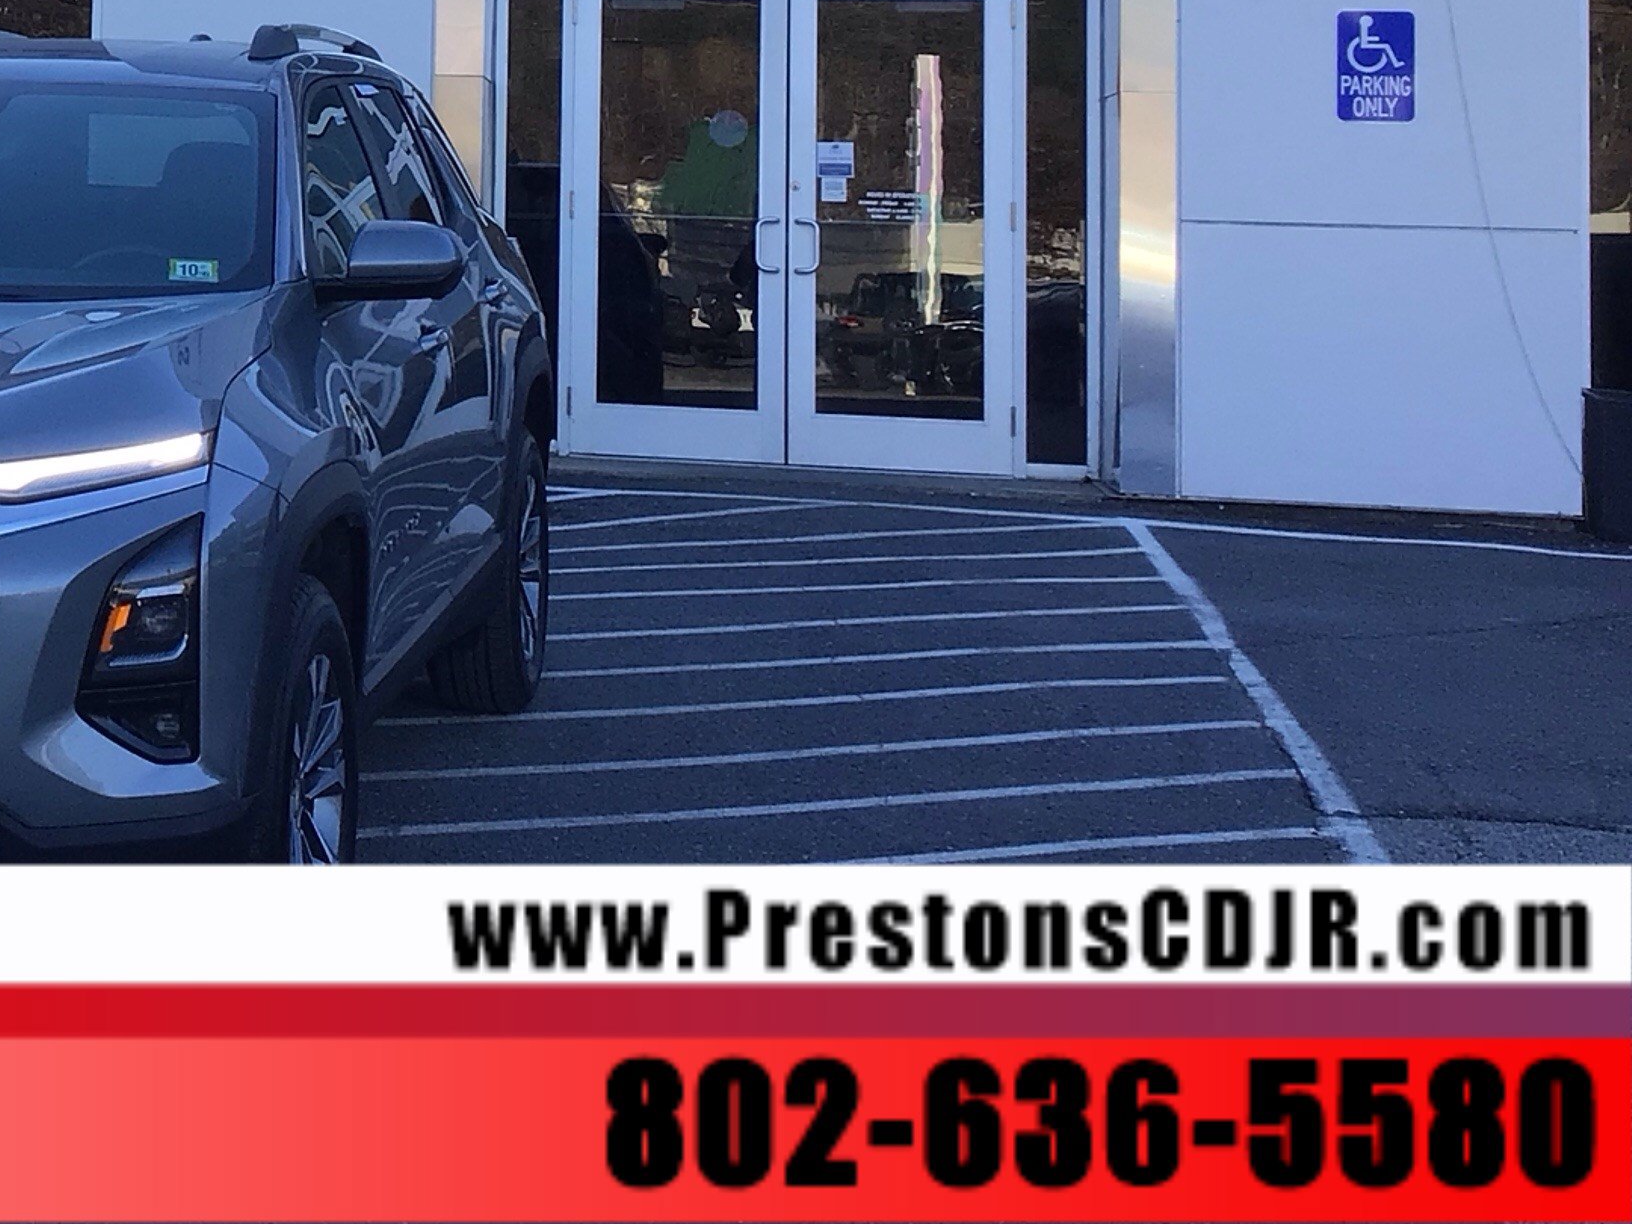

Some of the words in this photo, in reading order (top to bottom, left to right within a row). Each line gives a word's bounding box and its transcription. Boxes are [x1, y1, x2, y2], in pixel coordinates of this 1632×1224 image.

[1340, 74, 1412, 97] PARKING
[1352, 97, 1398, 117] ONLY
[179, 264, 198, 276] 10
